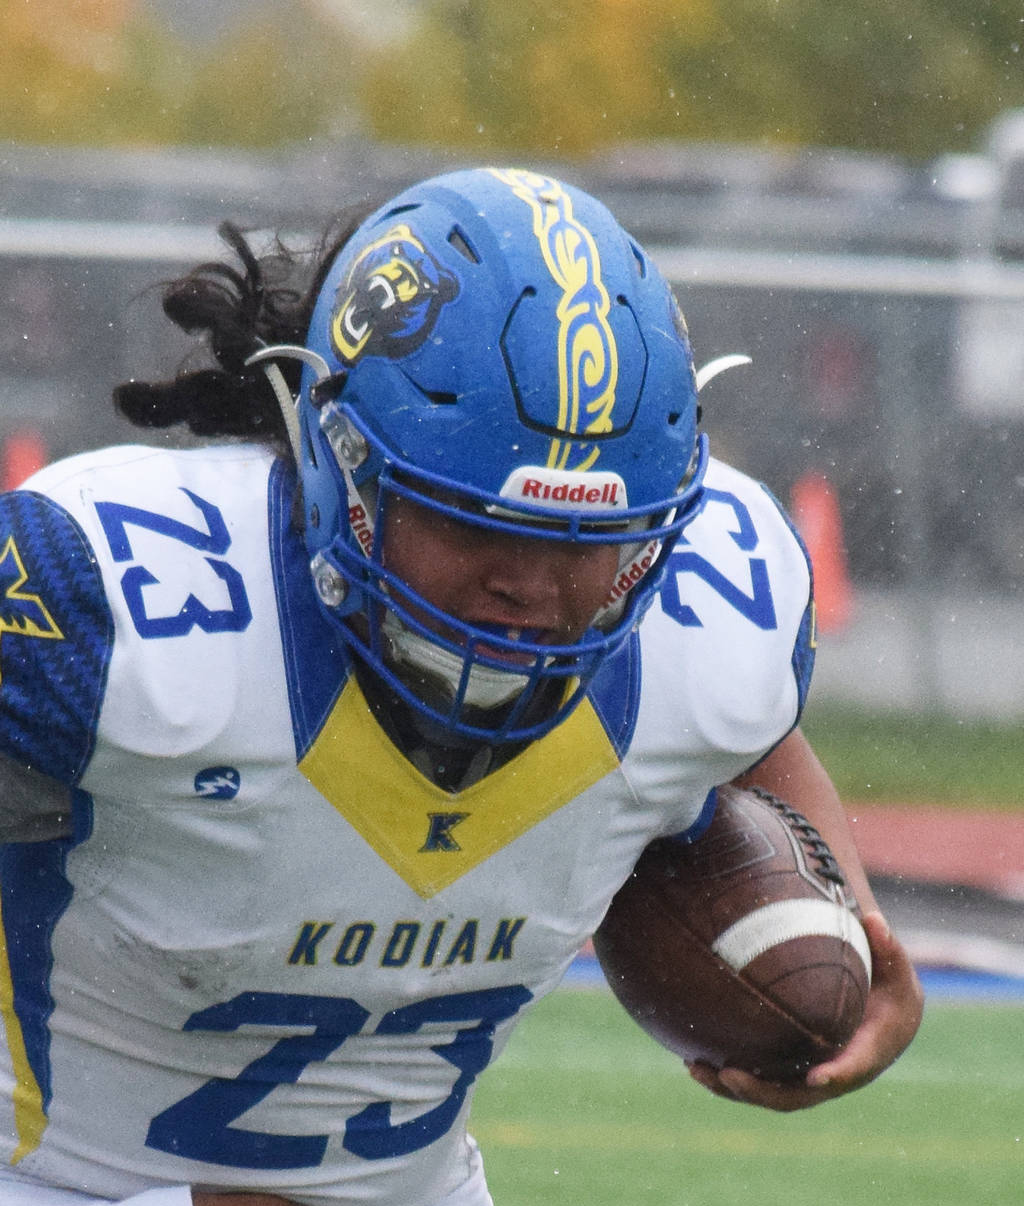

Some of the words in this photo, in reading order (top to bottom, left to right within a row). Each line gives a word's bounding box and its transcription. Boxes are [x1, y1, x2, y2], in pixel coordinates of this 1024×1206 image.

[522, 478, 617, 504] Riddell
[94, 487, 253, 639] 23
[418, 812, 470, 853] K
[287, 917, 527, 968] KODIAK
[144, 983, 534, 1170] 23
